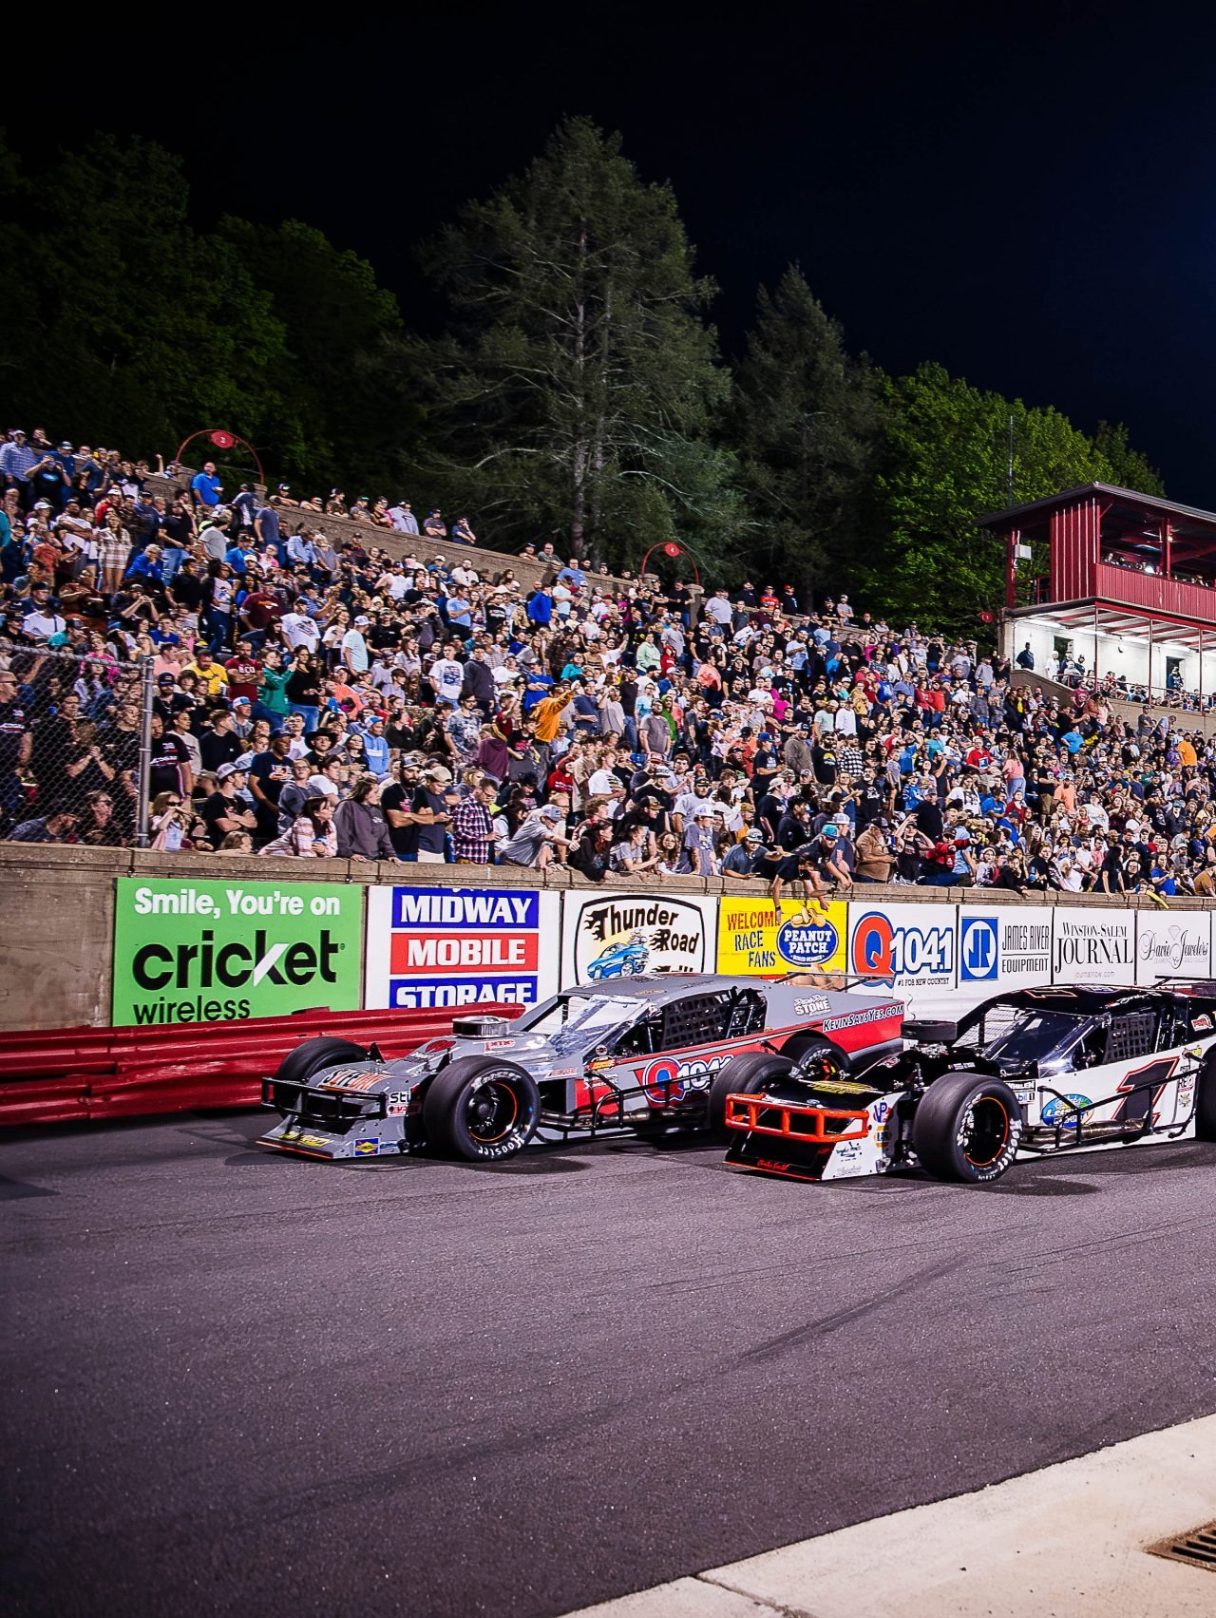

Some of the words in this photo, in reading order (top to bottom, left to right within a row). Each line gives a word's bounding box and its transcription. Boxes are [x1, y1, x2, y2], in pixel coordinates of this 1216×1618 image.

[134, 887, 221, 919] Smile,
[226, 889, 304, 916] You're
[310, 897, 341, 916] on
[401, 895, 532, 924] MIDWAY
[584, 903, 680, 943] Thunder
[727, 910, 781, 931] WELCOM
[1062, 921, 1127, 938] WINSTON-SALEM
[649, 928, 700, 955] Road
[735, 930, 764, 951] RACE
[784, 929, 832, 942] PEANUT
[789, 942, 829, 954] PATCH
[1002, 925, 1028, 951] JAMES
[1029, 925, 1050, 950] RIVER
[132, 929, 339, 991] cricket
[407, 939, 526, 967] MOBILE
[748, 951, 776, 968] FANS
[1002, 957, 1049, 973] EQUIPMENT
[1054, 937, 1134, 974] JOURNAL
[927, 977, 950, 986] COUNTRY
[396, 982, 533, 1009] STORAGE
[794, 1000, 832, 1015] STONE
[133, 995, 251, 1025] wireless
